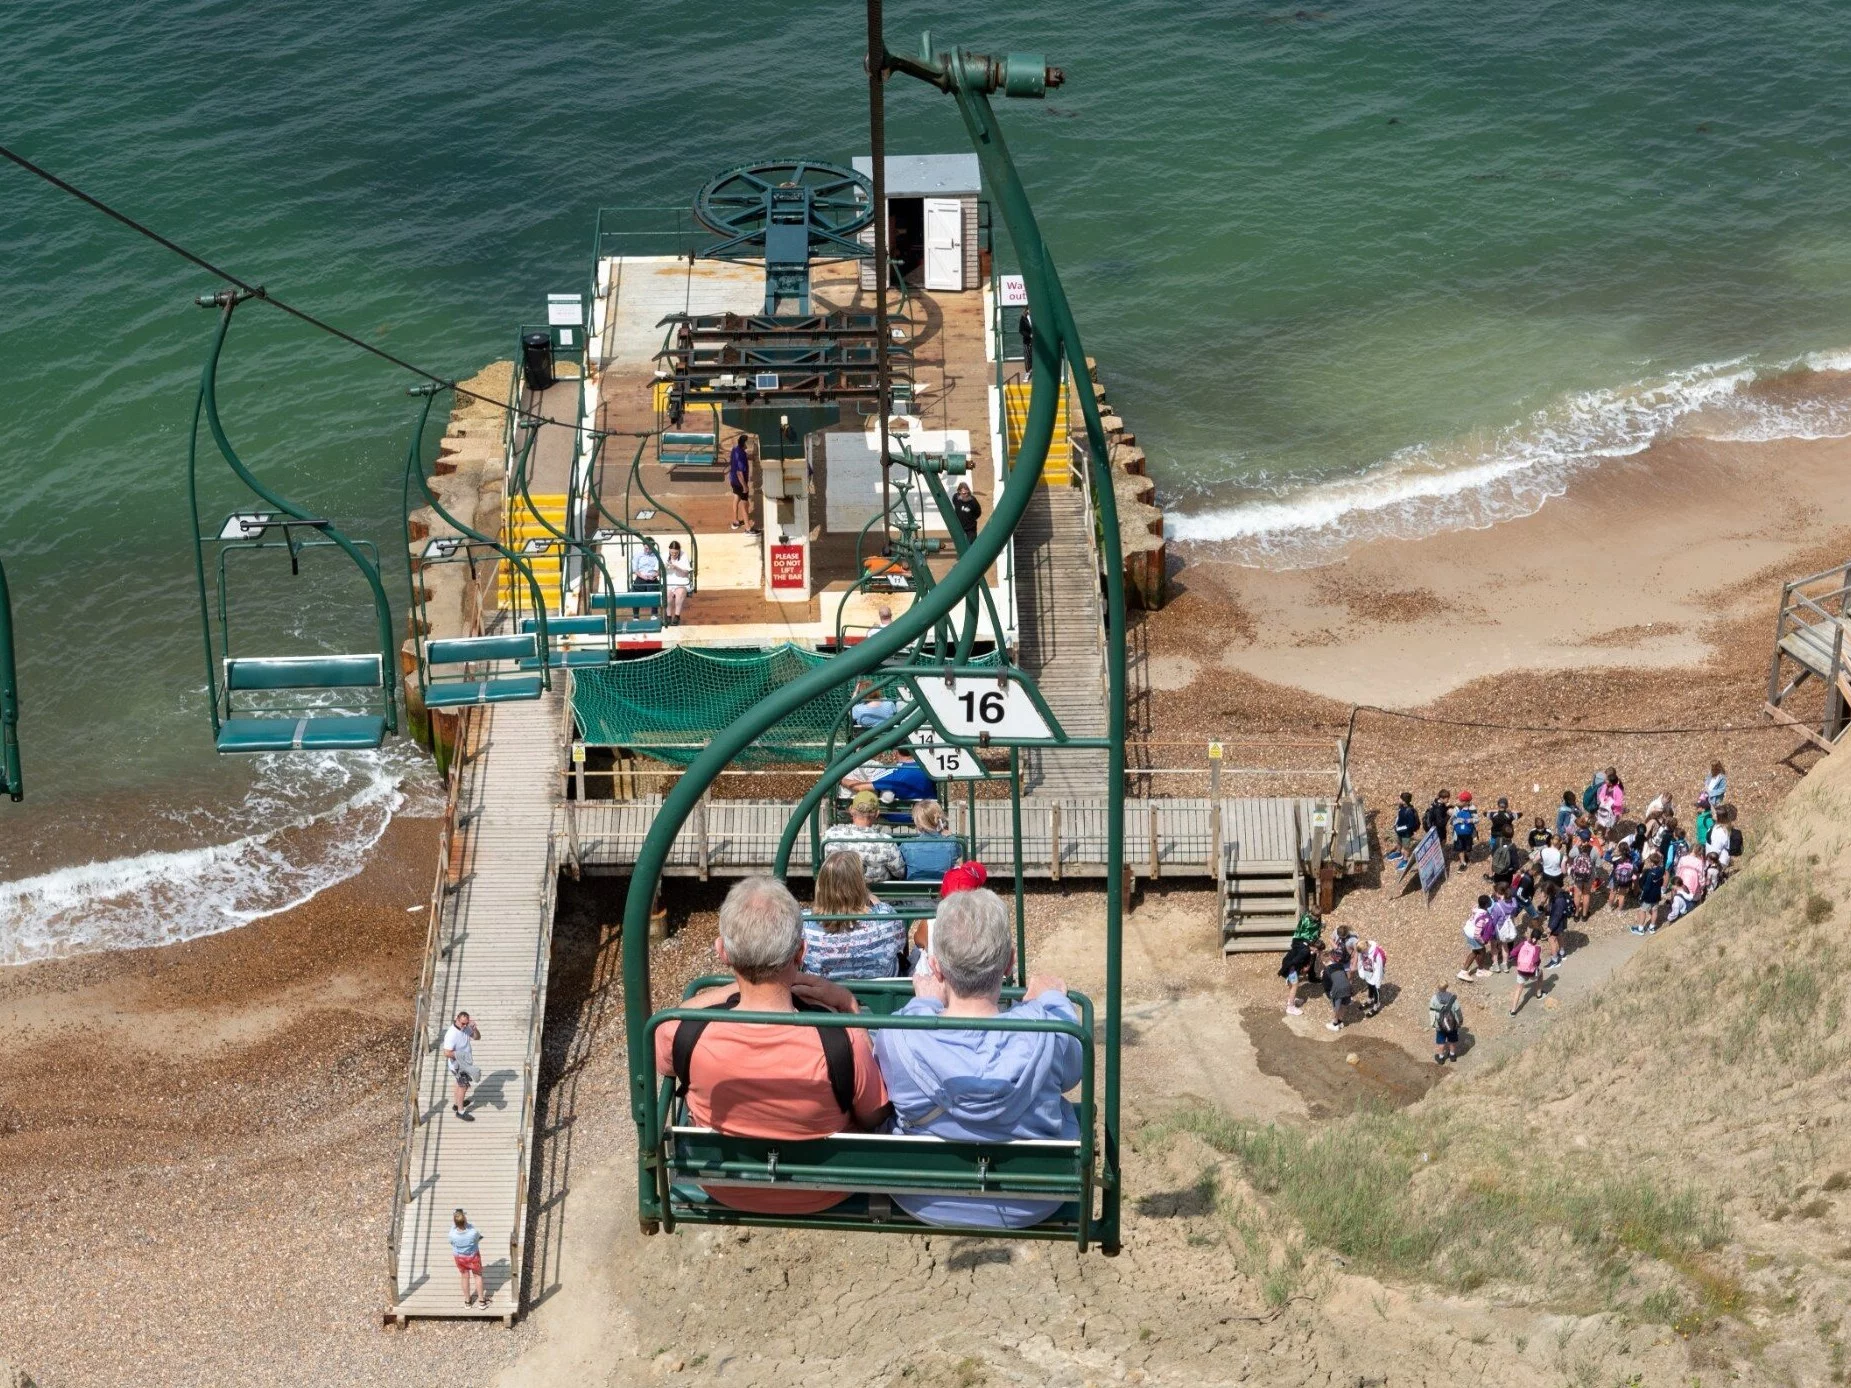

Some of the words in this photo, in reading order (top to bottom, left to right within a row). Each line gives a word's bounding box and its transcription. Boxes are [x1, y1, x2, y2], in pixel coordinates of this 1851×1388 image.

[1007, 282, 1023, 290] Wa
[958, 690, 1005, 724] 16
[919, 734, 934, 744] 14
[936, 754, 960, 771] 15
